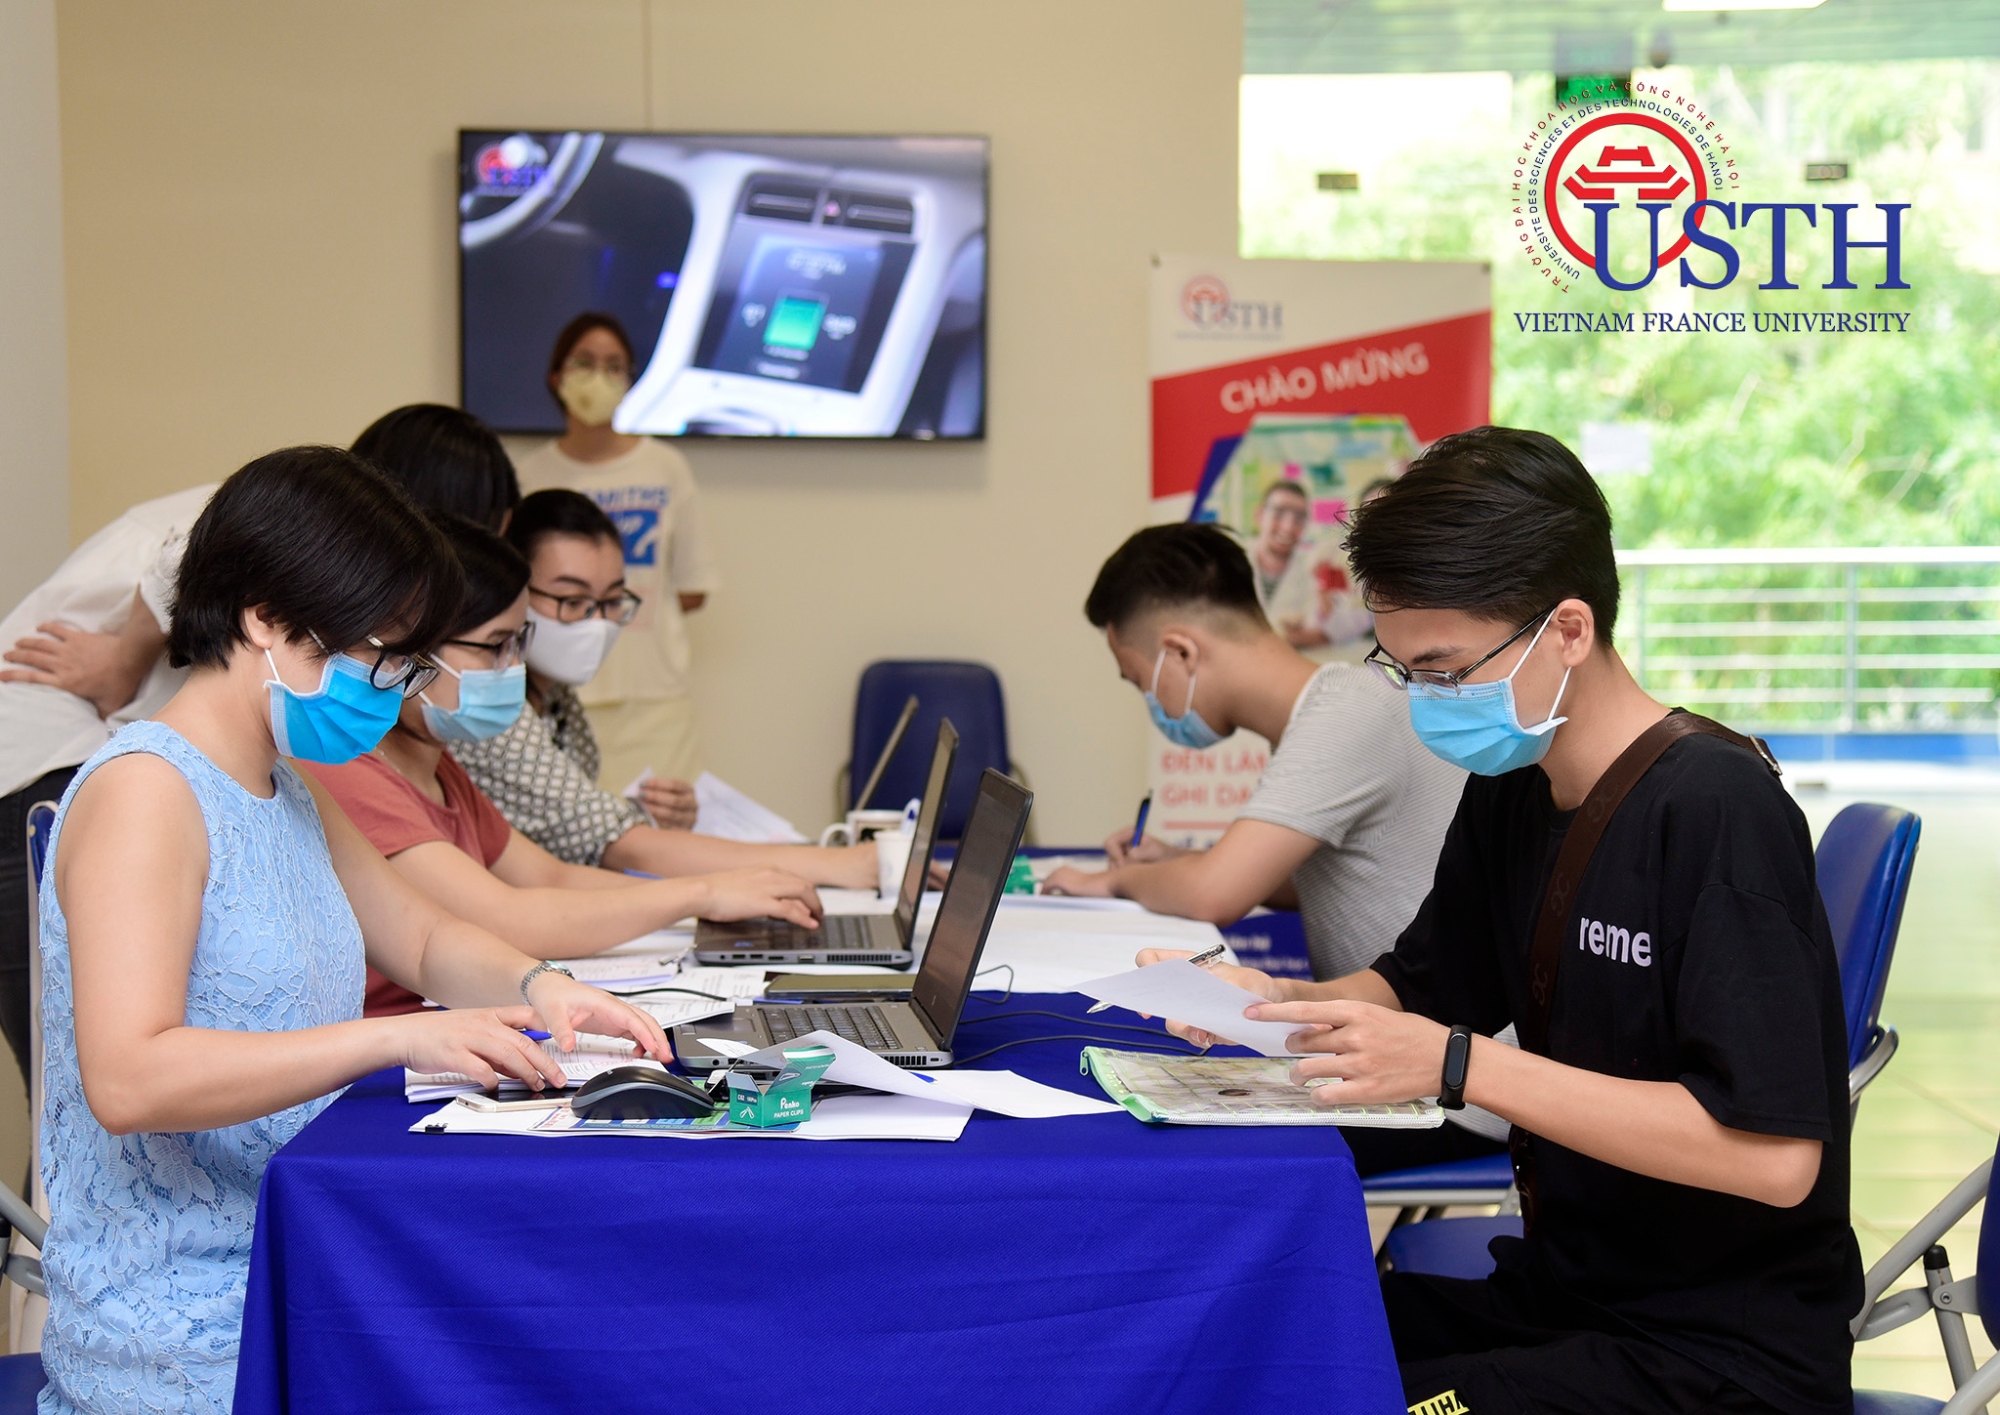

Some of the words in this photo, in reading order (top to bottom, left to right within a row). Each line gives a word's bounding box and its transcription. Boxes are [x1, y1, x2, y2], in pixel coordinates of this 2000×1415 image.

[1219, 364, 1318, 414] CHÀO
[1579, 917, 1652, 967] reme
[773, 1111, 789, 1119] PAPER
[789, 1109, 804, 1117] CLIPS
[780, 1097, 800, 1110] Penko
